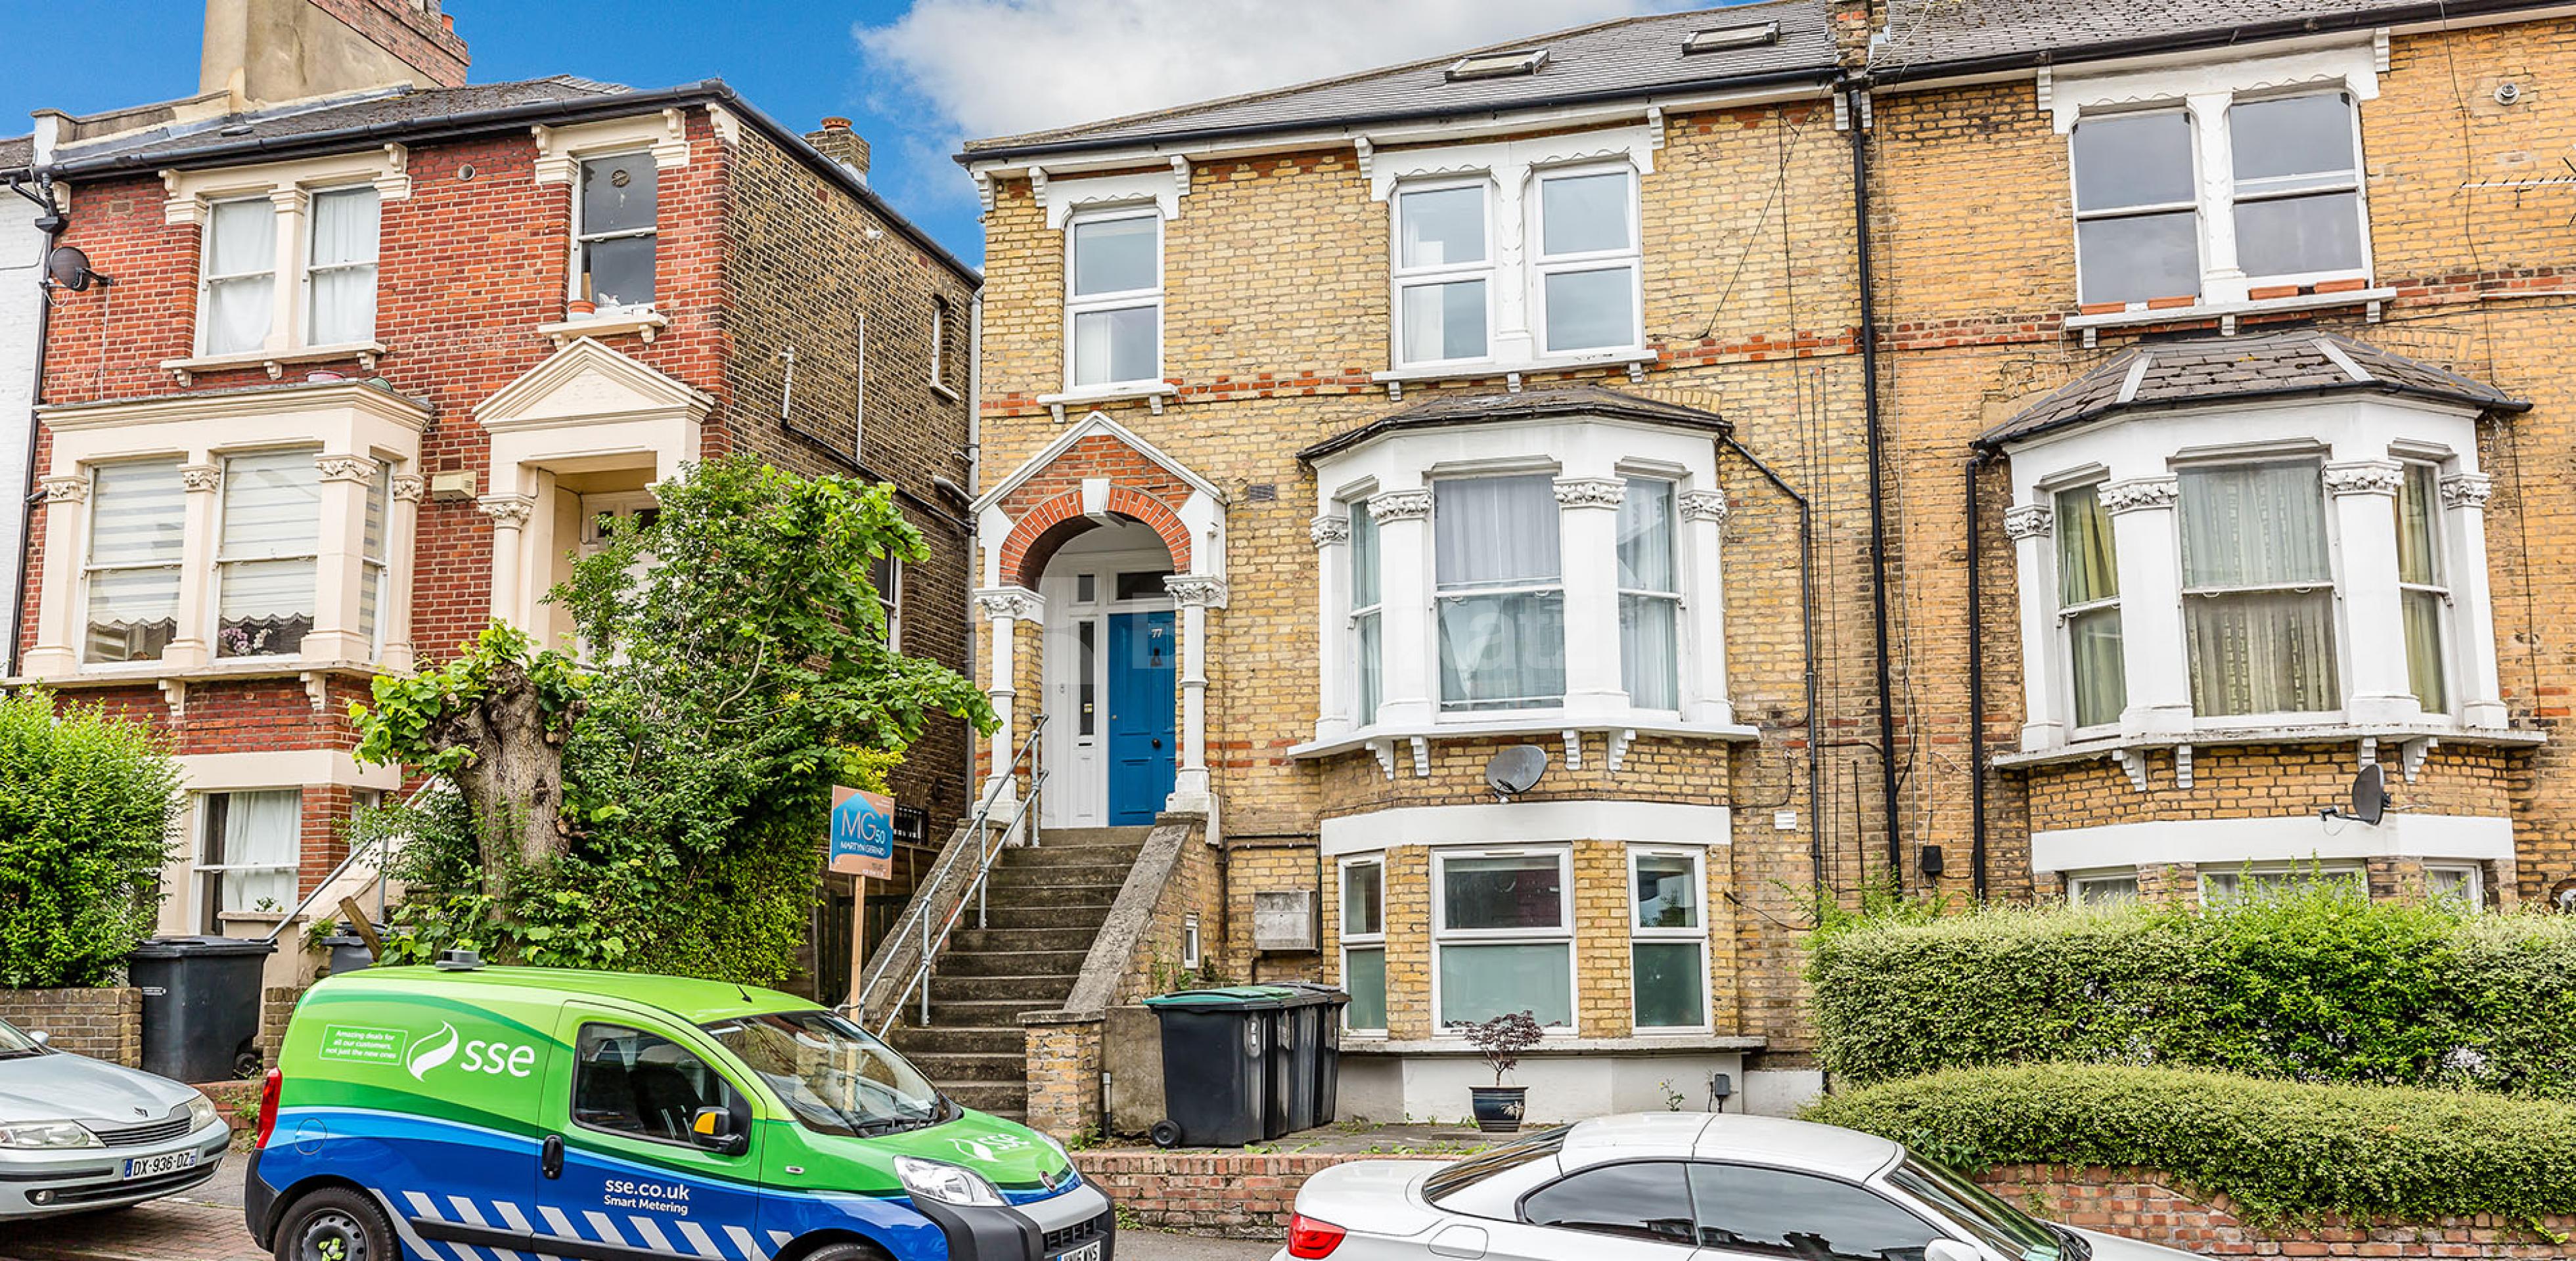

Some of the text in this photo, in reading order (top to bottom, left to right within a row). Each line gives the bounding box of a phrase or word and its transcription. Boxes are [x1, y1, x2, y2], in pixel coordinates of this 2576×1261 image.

[1151, 629, 1163, 638] 77
[336, 1029, 365, 1040] Amazing
[365, 1032, 383, 1040] deals
[460, 1040, 535, 1078] sse
[133, 1152, 190, 1175] DX-936-DZ
[605, 1179, 690, 1201] sse.co.uk
[604, 1195, 689, 1216] Smart Metering
